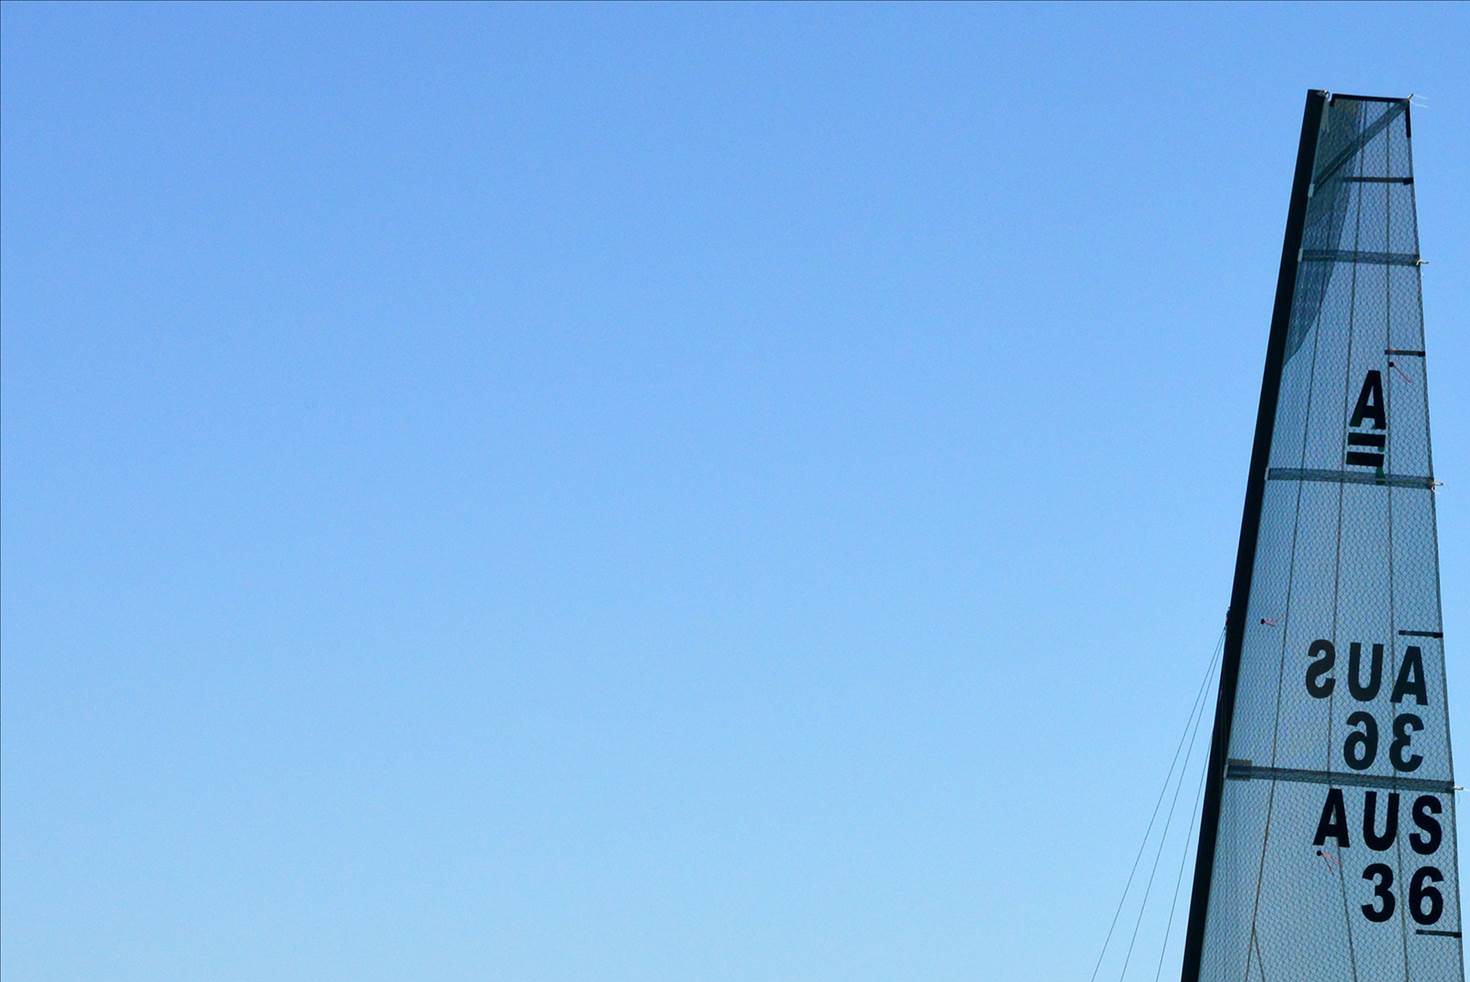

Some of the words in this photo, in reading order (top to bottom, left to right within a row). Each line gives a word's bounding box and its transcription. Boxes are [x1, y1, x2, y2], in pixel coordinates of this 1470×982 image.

[1350, 370, 1387, 430] A
[1313, 788, 1443, 855] AUS
[1361, 863, 1444, 925] 36
